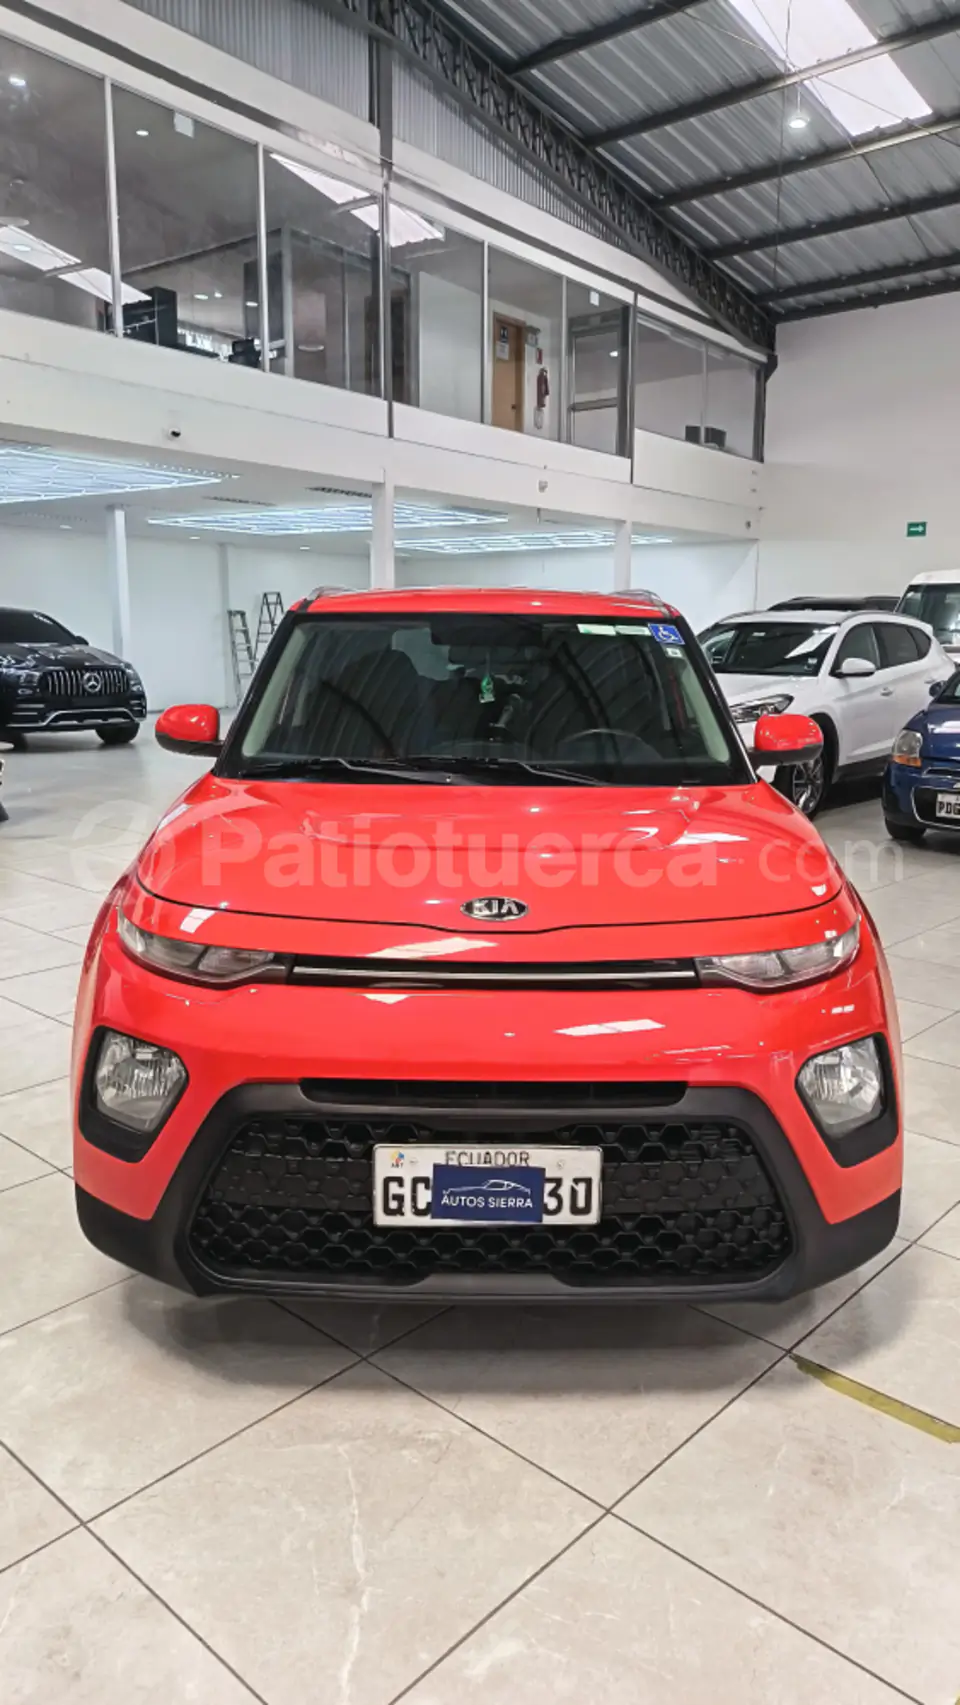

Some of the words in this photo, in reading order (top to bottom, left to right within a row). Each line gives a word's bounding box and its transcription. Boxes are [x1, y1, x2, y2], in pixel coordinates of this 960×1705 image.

[473, 899, 519, 915] KIA
[446, 1151, 529, 1167] ECUADOR
[441, 1195, 485, 1208] AUTOS
[488, 1196, 533, 1209] SIERRA
